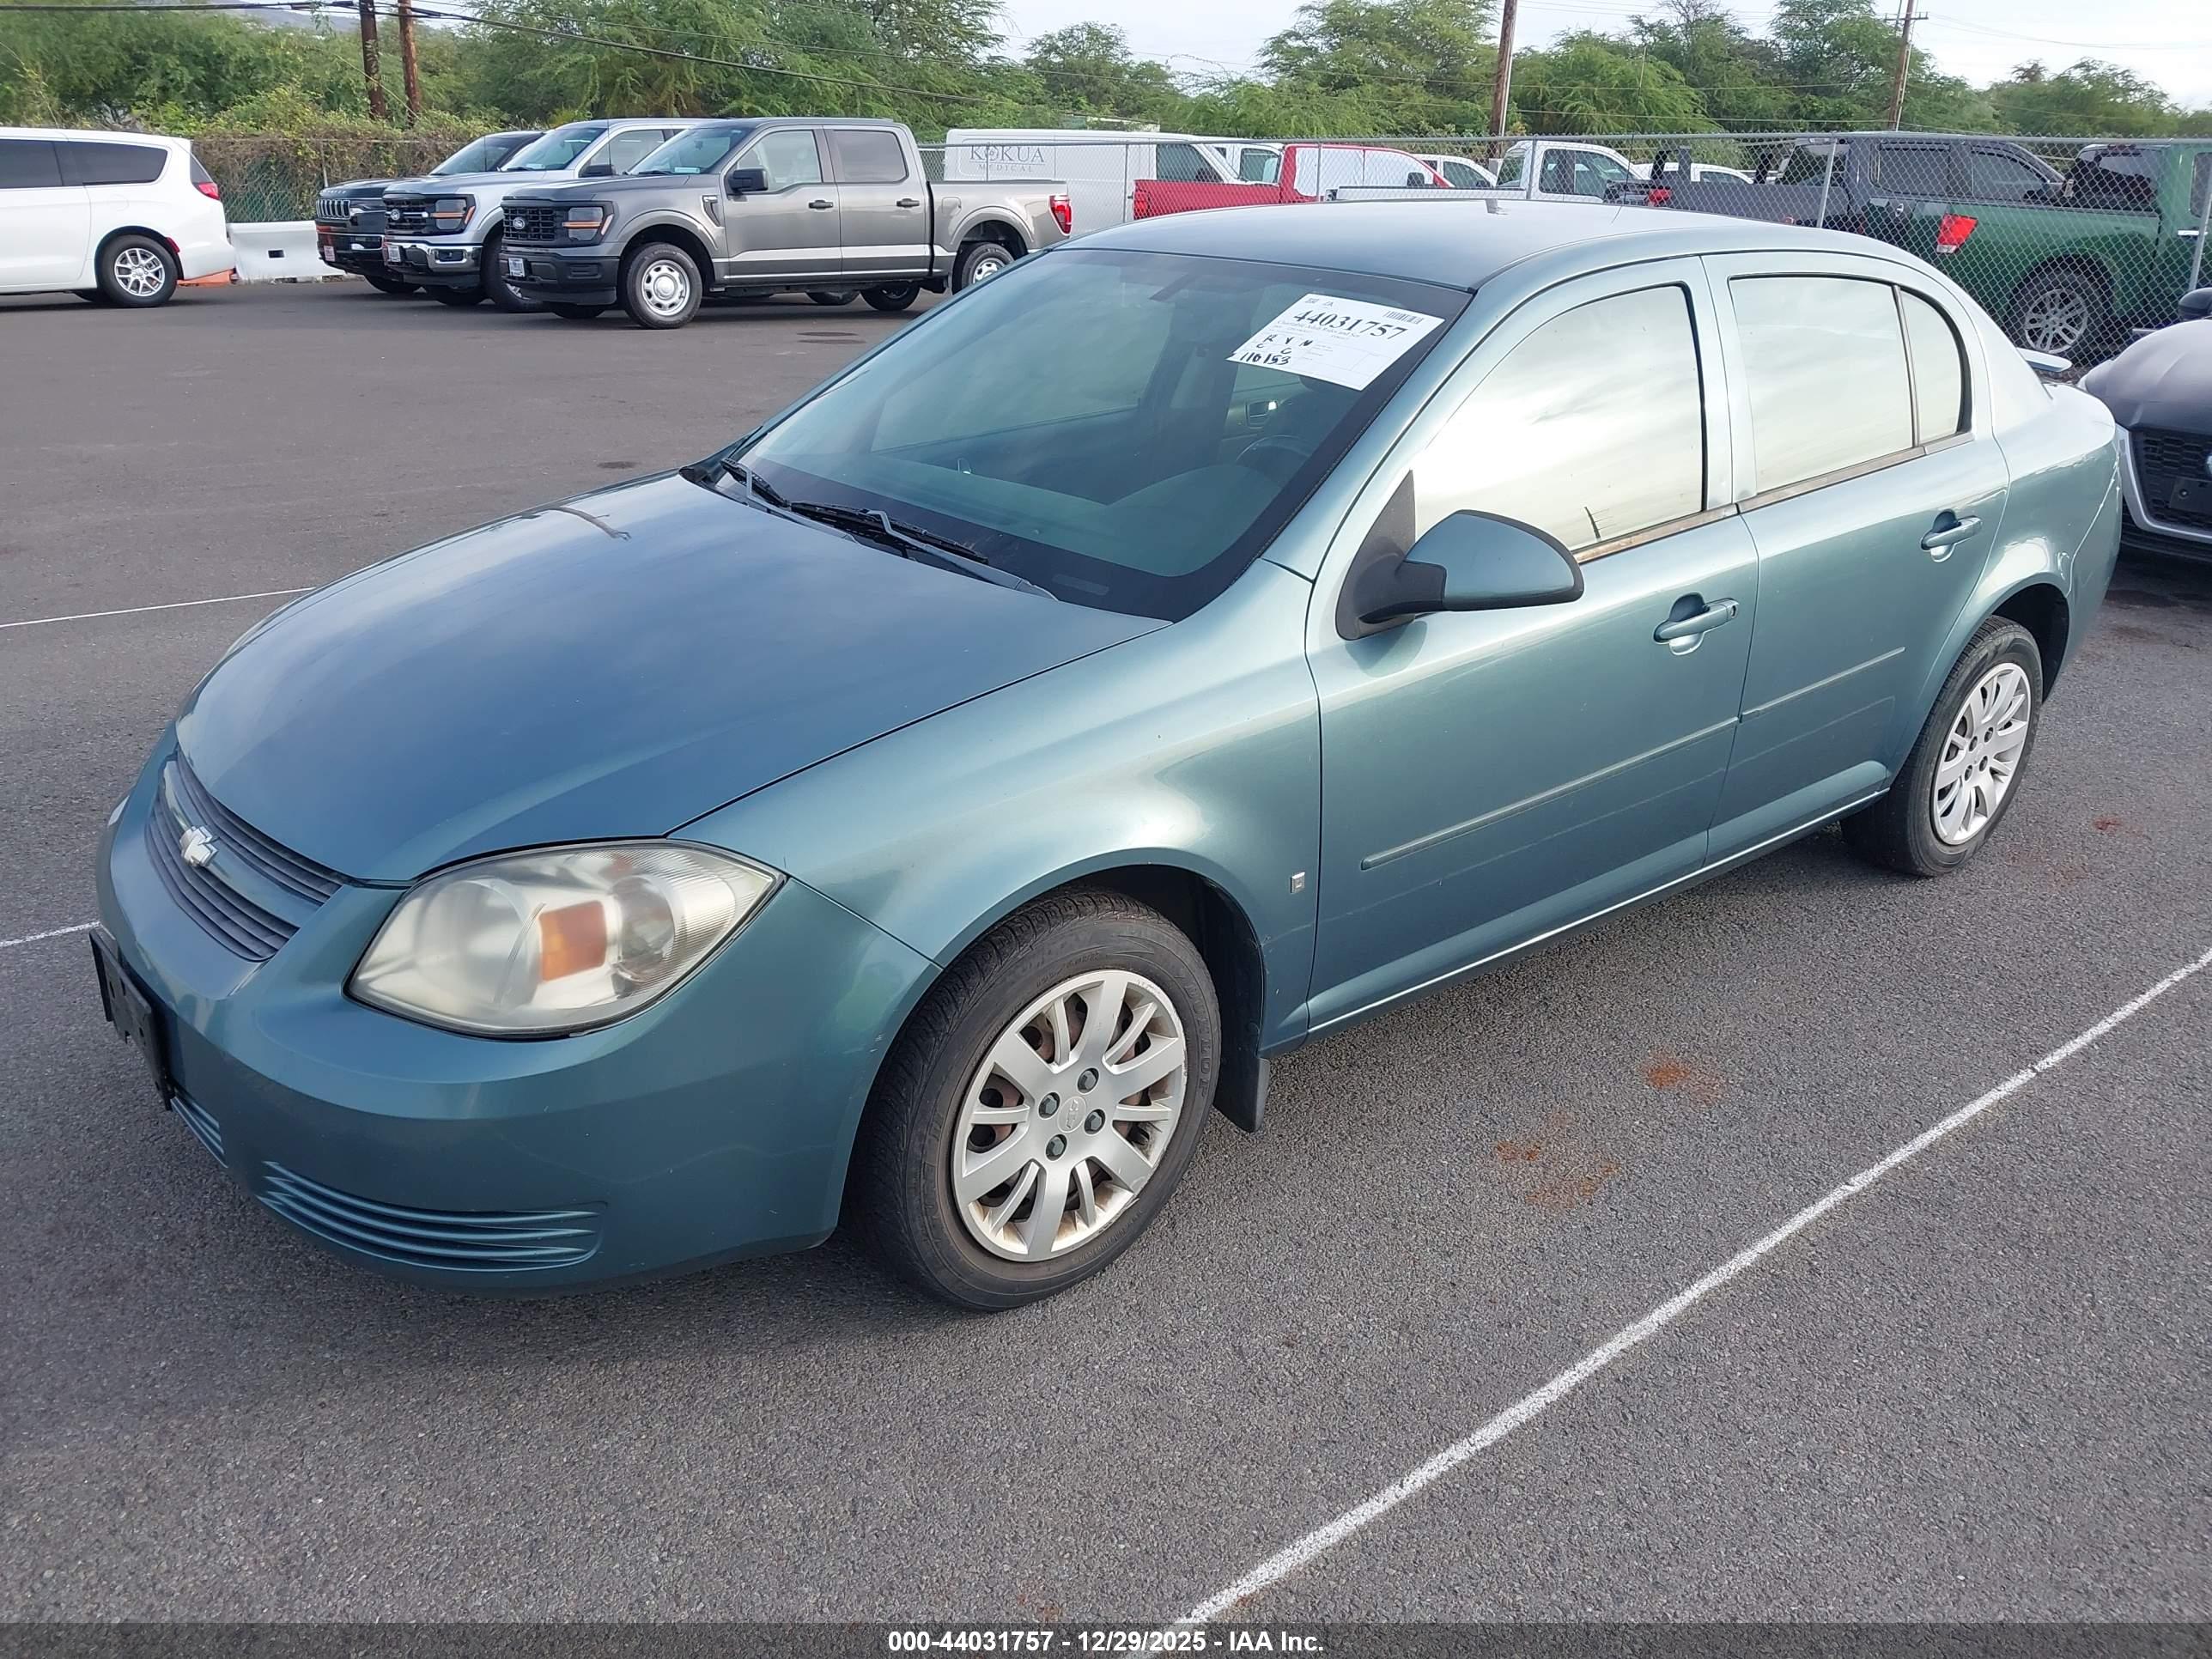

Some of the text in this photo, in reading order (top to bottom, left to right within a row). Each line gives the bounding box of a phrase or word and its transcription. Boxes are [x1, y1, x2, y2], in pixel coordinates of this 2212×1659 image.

[969, 145, 1045, 162] KOKUA
[977, 164, 1034, 173] MEDICAL
[1293, 310, 1408, 340] 44031757
